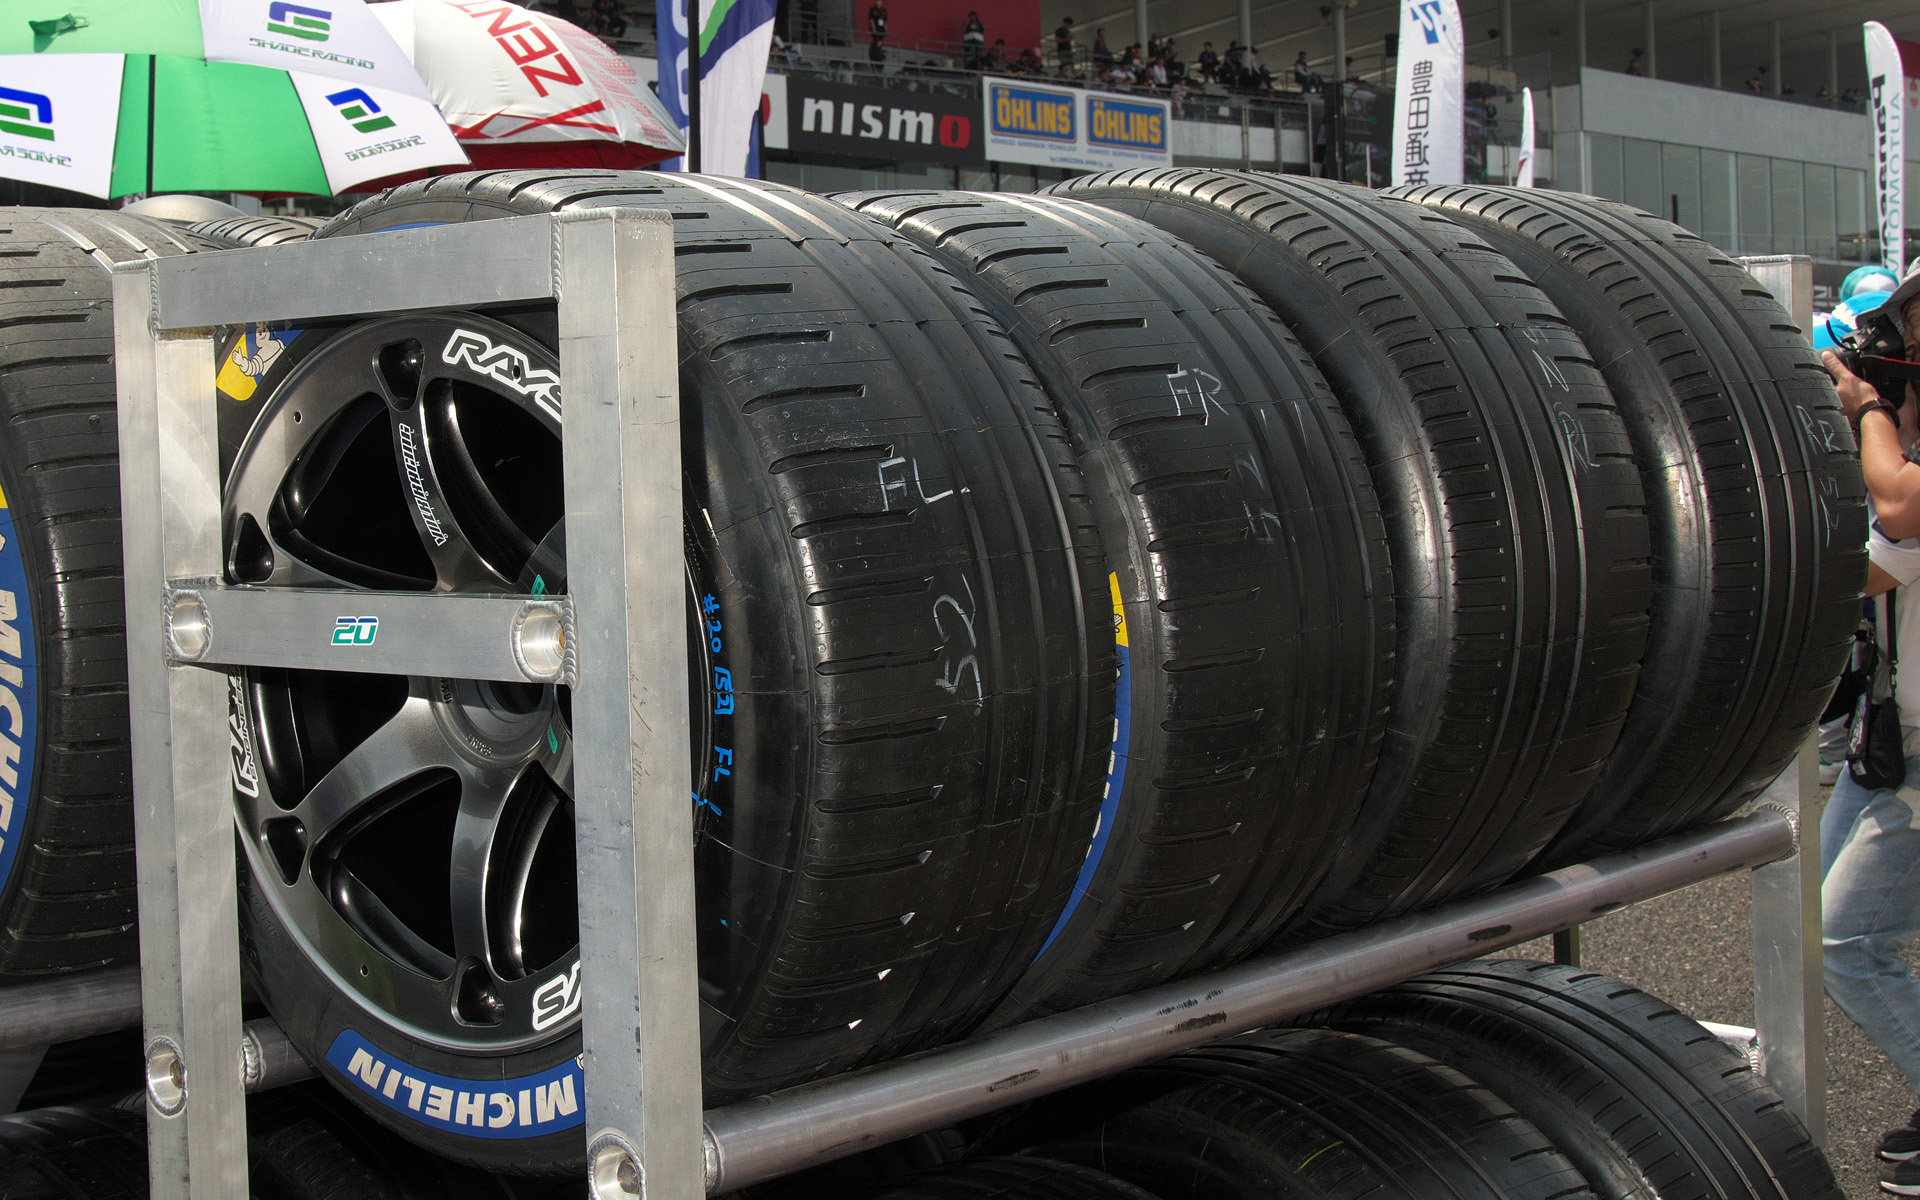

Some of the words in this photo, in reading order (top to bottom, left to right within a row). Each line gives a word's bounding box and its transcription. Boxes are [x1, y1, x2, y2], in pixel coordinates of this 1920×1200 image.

[249, 37, 310, 57] SHADE
[311, 49, 375, 70] RACING
[444, 0, 583, 98] ZENT
[802, 97, 970, 149] nismo
[997, 88, 1072, 136] ÖHLINS
[1092, 100, 1163, 146] ÖHLINS
[331, 616, 379, 646] 20
[703, 593, 722, 653] #20
[714, 745, 732, 782] FL
[346, 1047, 578, 1128] MICHELIN
